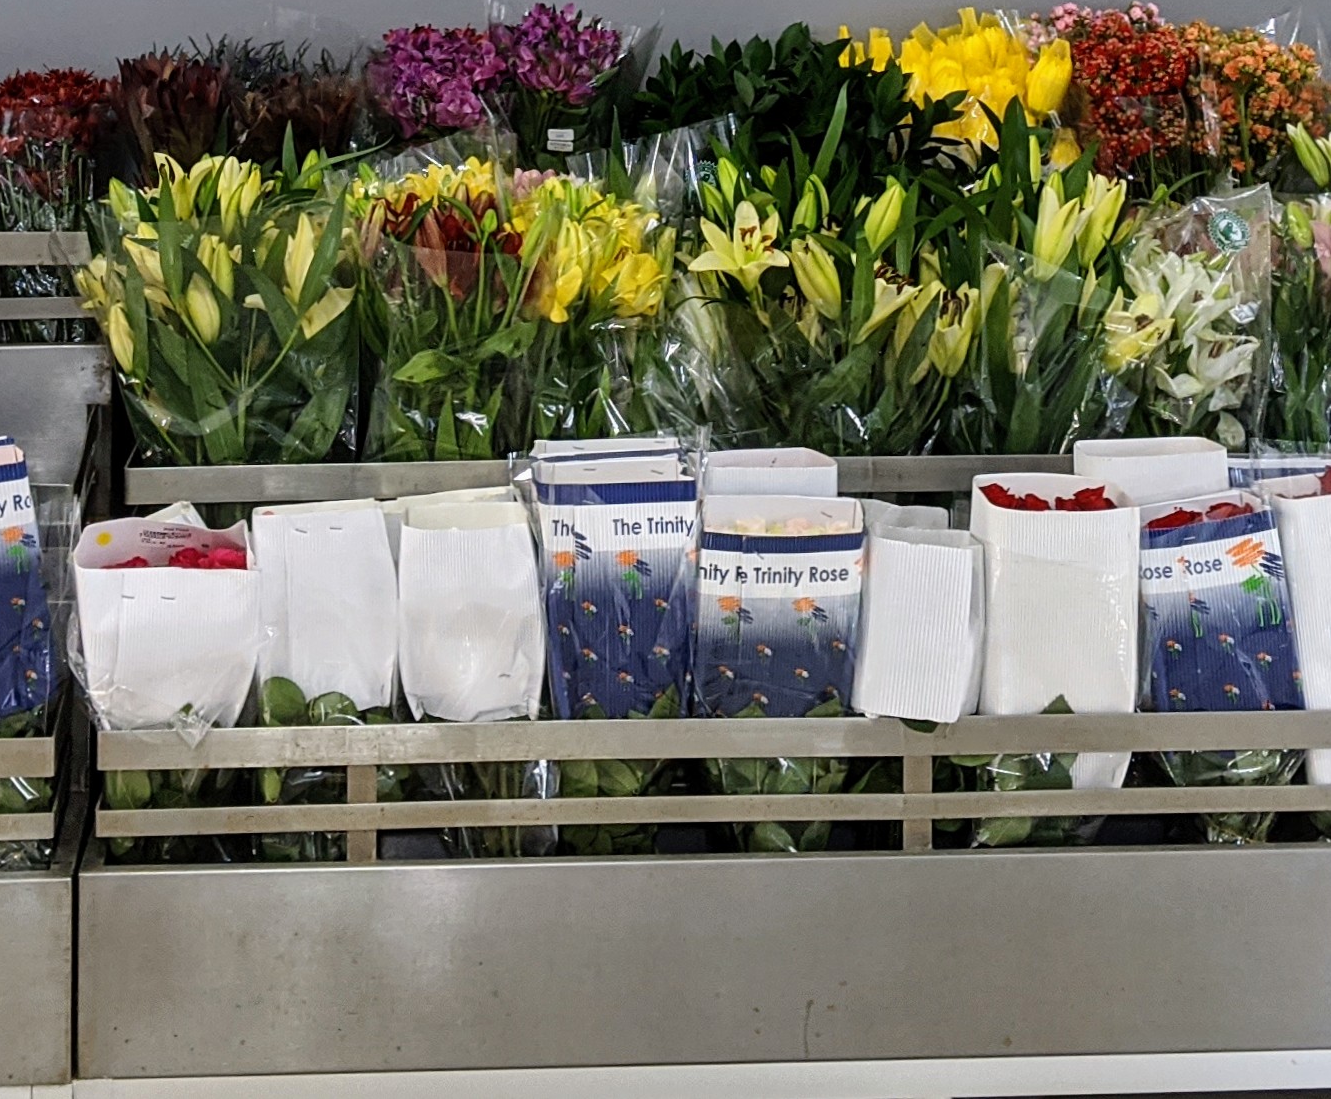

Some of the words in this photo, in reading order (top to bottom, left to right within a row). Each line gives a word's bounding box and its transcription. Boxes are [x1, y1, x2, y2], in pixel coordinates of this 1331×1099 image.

[612, 518, 643, 536] The
[647, 515, 695, 537] Trinity
[753, 566, 804, 587] Trinity
[809, 566, 850, 583] Rose
